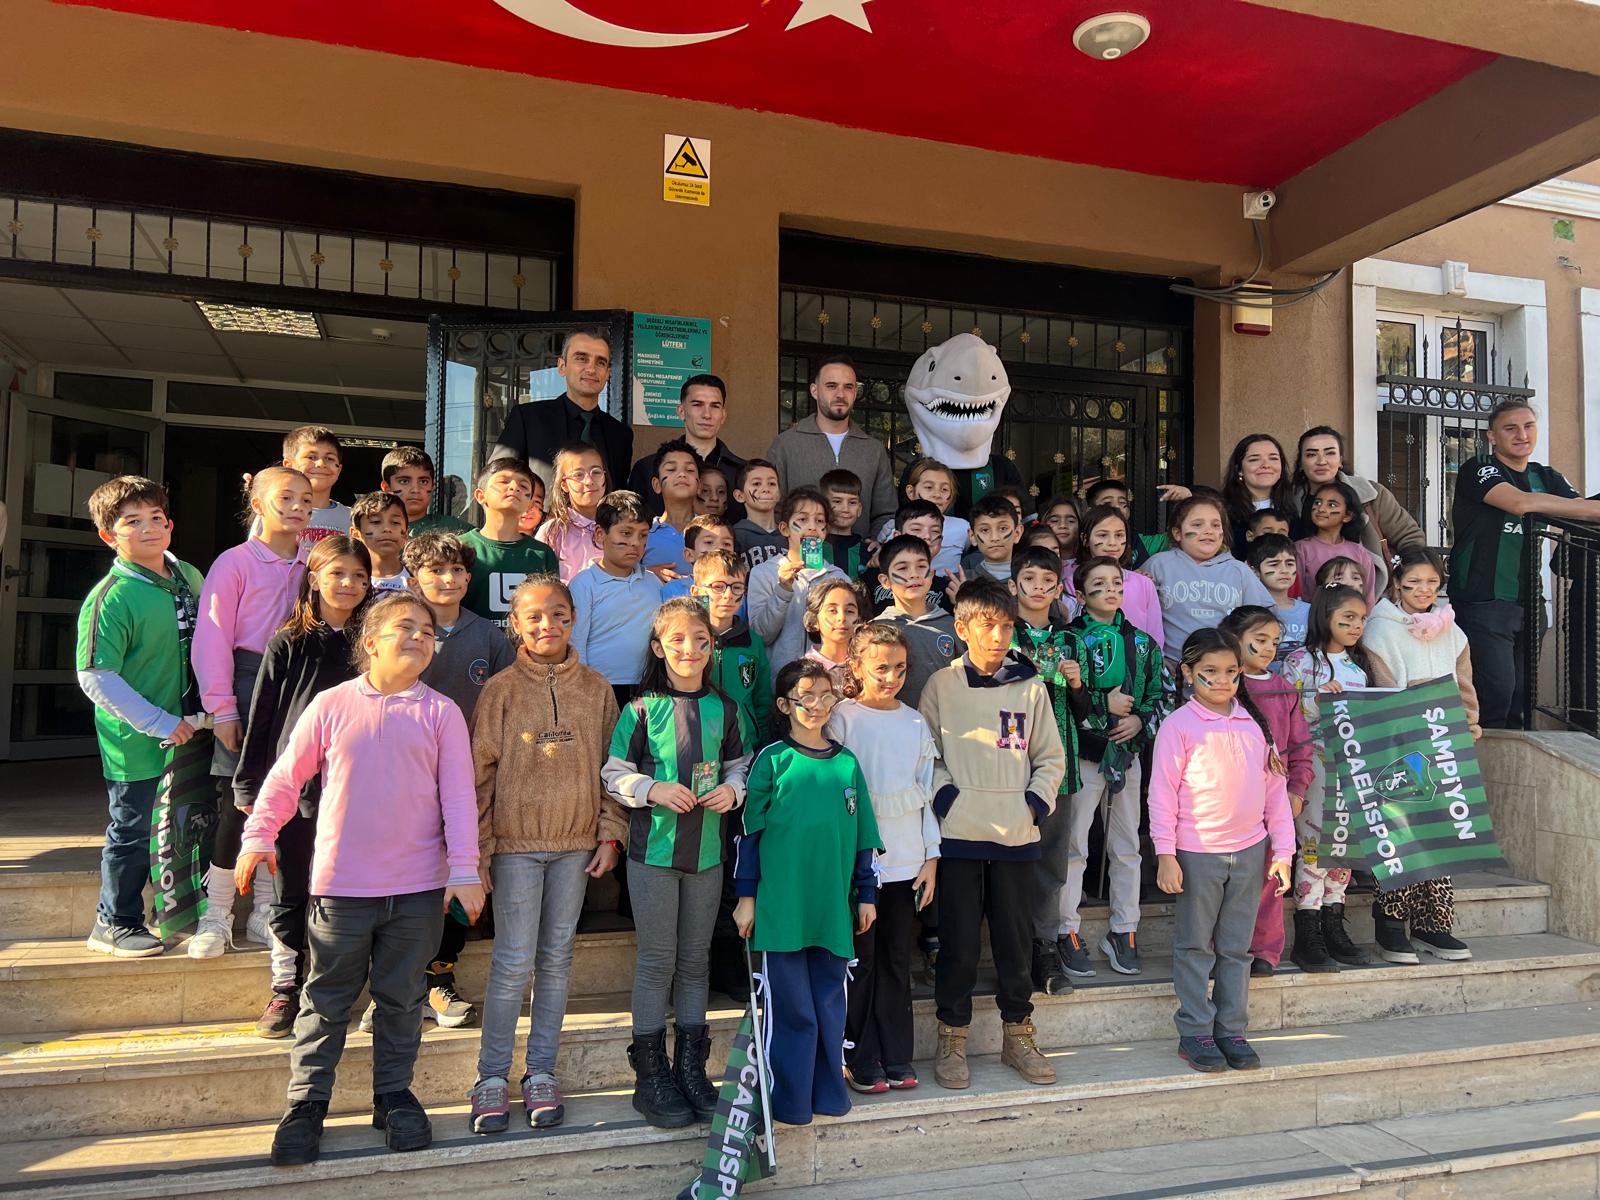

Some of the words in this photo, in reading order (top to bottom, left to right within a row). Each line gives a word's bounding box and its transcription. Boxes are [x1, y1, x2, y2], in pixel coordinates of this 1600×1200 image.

[661, 340, 683, 349] LÜTFEN
[1162, 580, 1243, 609] BOSTON
[1422, 706, 1477, 841] ŞAMPİYON
